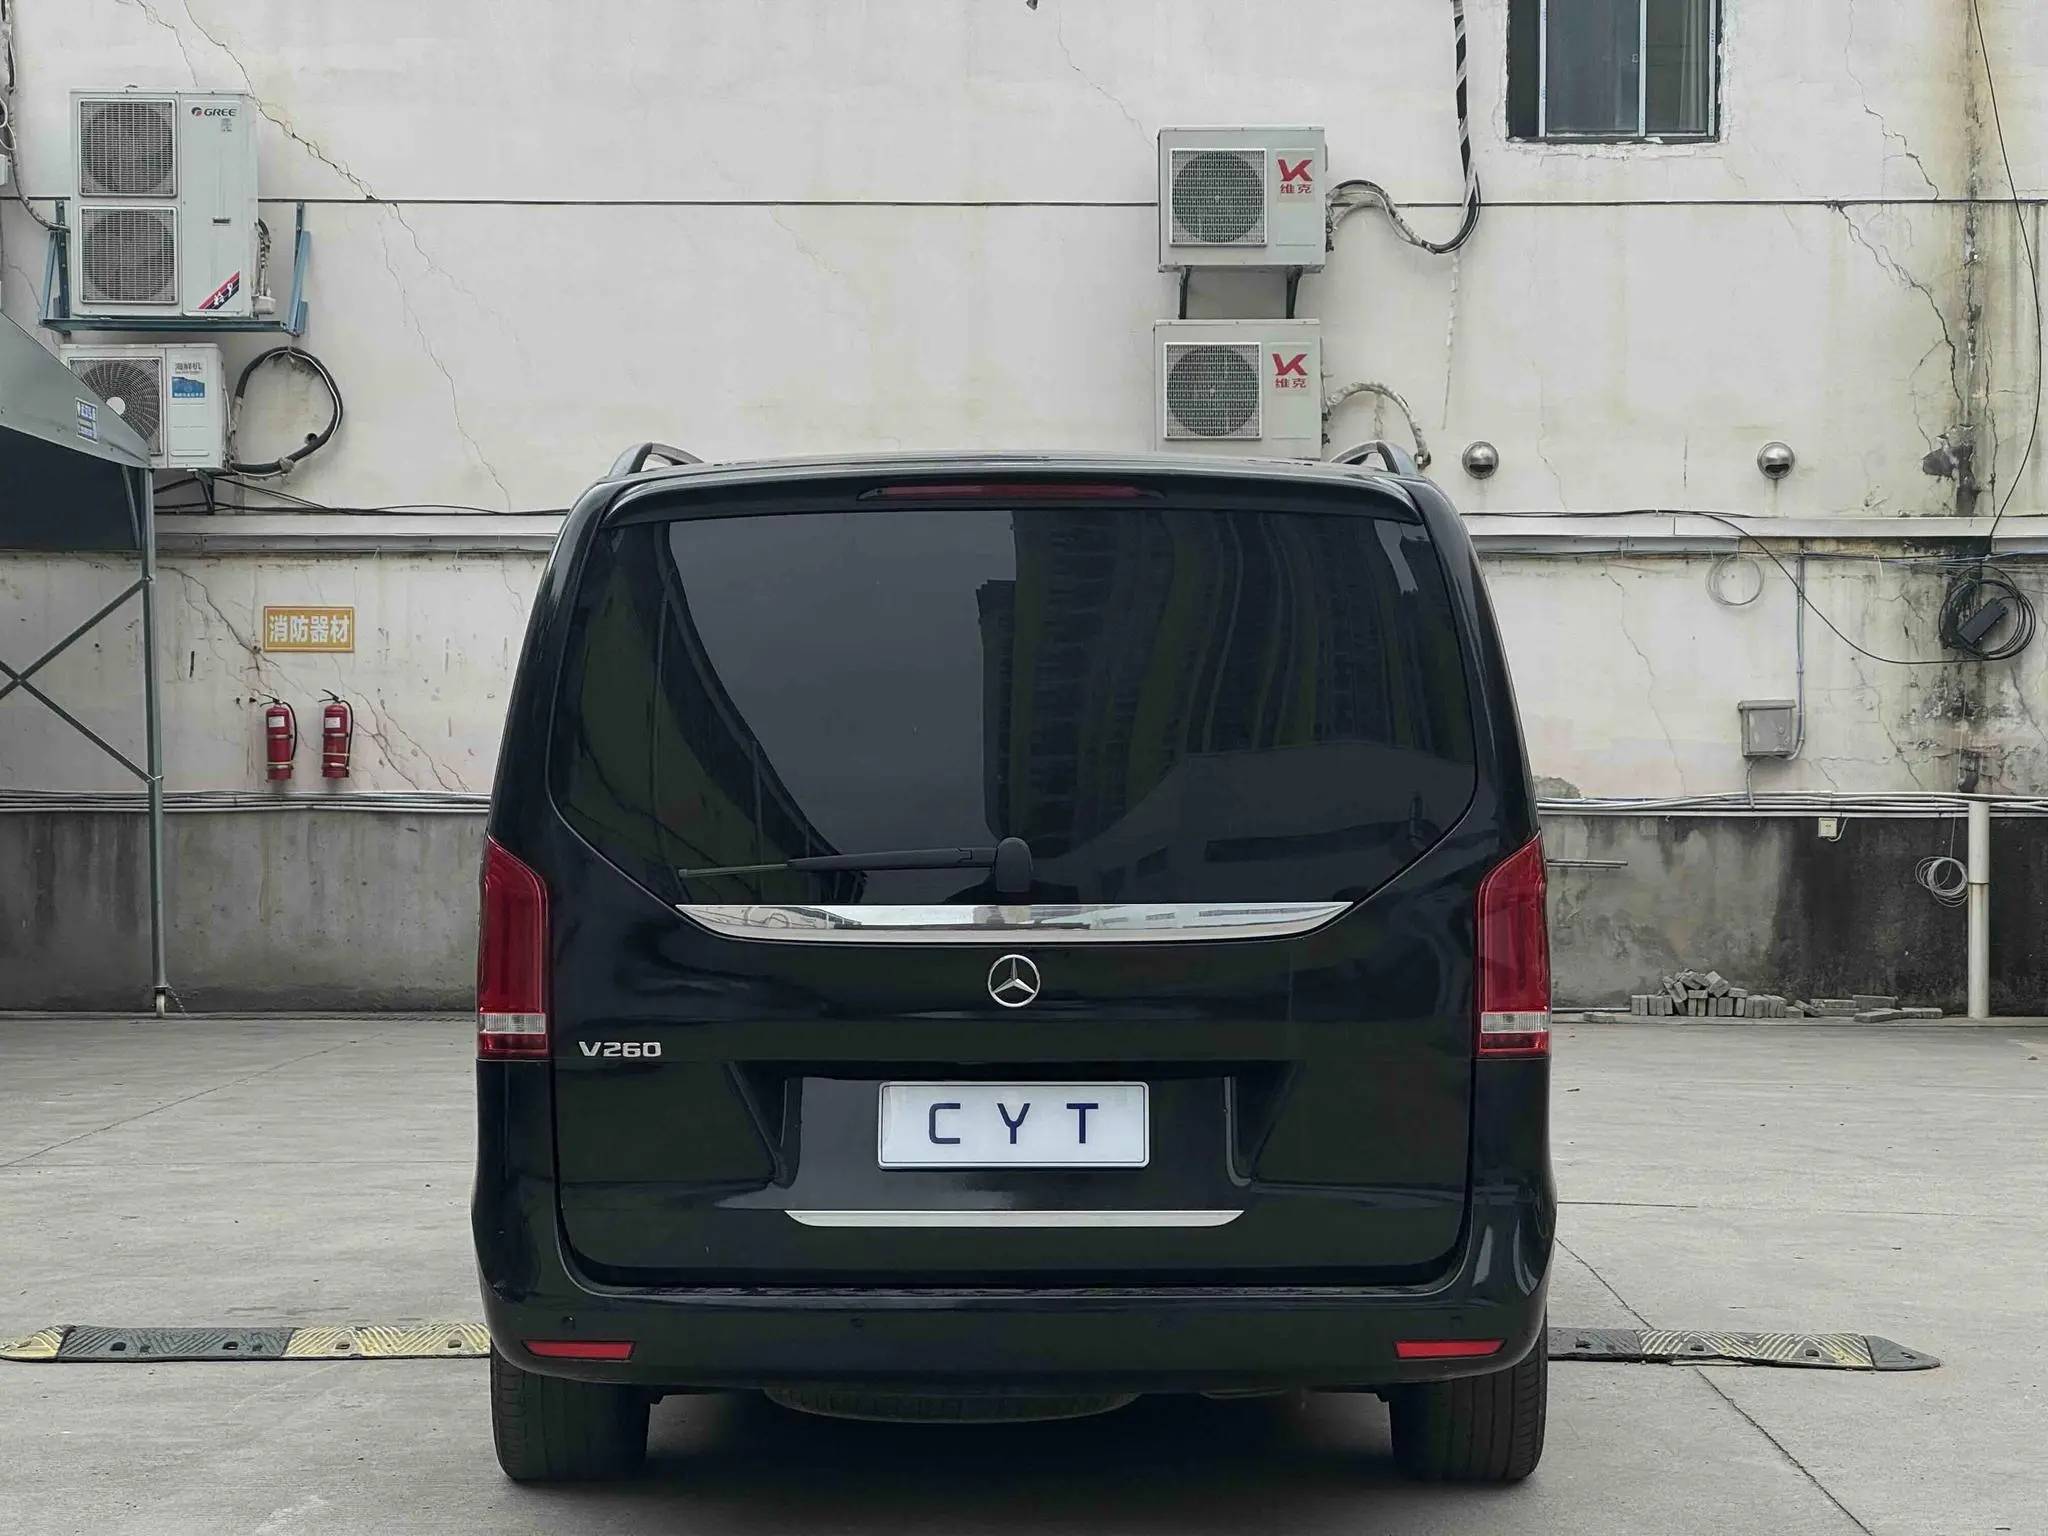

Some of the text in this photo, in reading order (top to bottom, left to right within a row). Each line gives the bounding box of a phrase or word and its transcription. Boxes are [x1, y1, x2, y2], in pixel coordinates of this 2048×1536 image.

[203, 108, 237, 117] GREE
[1280, 183, 1312, 194] 维克
[1275, 377, 1307, 389] 维克
[269, 614, 350, 643] 消防器材
[578, 1041, 662, 1057] V260
